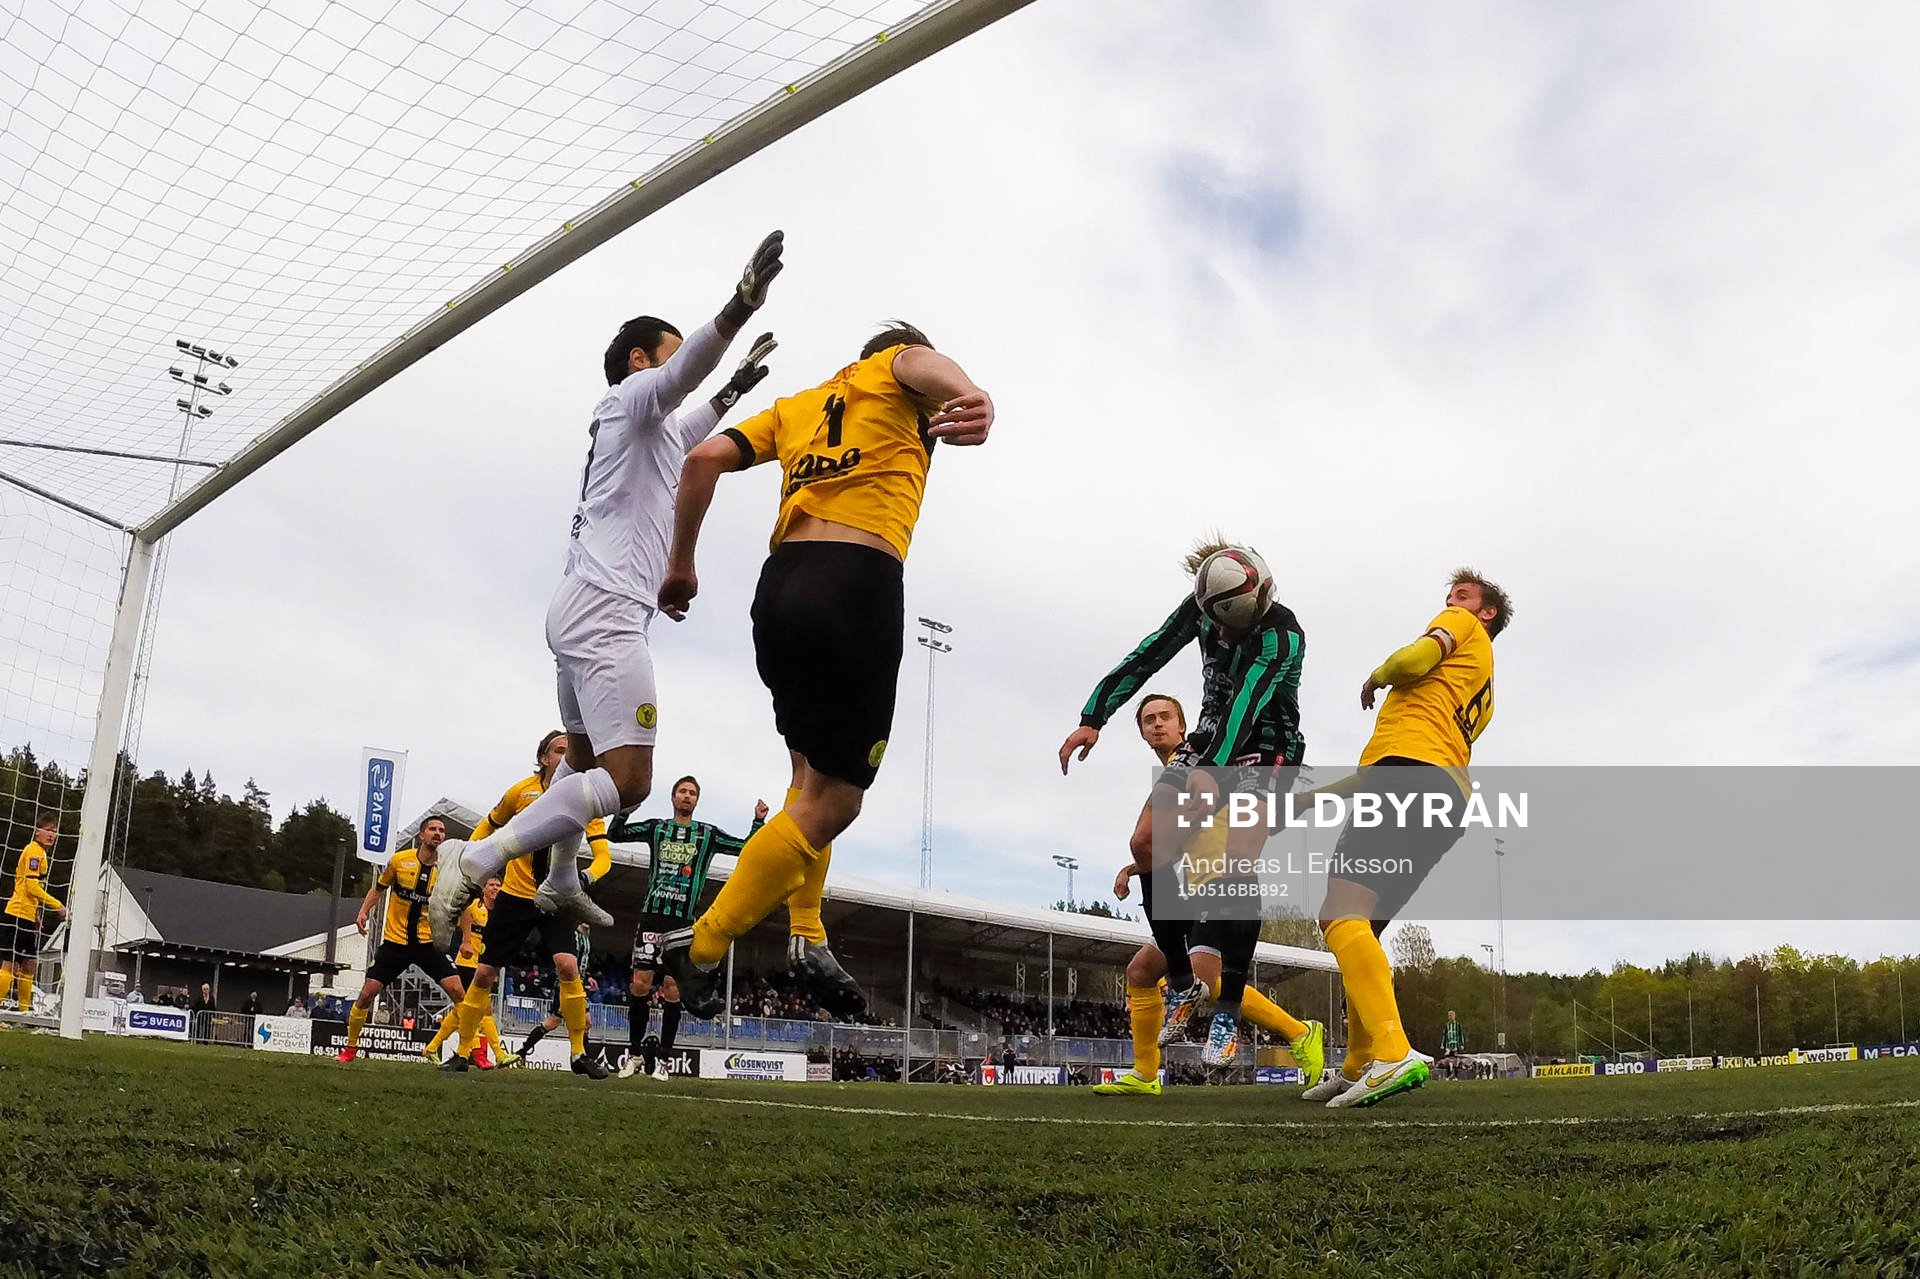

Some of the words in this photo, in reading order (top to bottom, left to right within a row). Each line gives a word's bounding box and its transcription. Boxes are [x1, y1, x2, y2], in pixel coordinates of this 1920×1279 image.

[149, 1016, 183, 1028] SVEAB
[331, 1035, 372, 1049] ENGAND
[374, 1038, 394, 1050] OCH
[394, 1040, 427, 1053] ITALIEN
[1807, 1050, 1849, 1062] weber
[735, 1057, 784, 1071] ROSENQVIST
